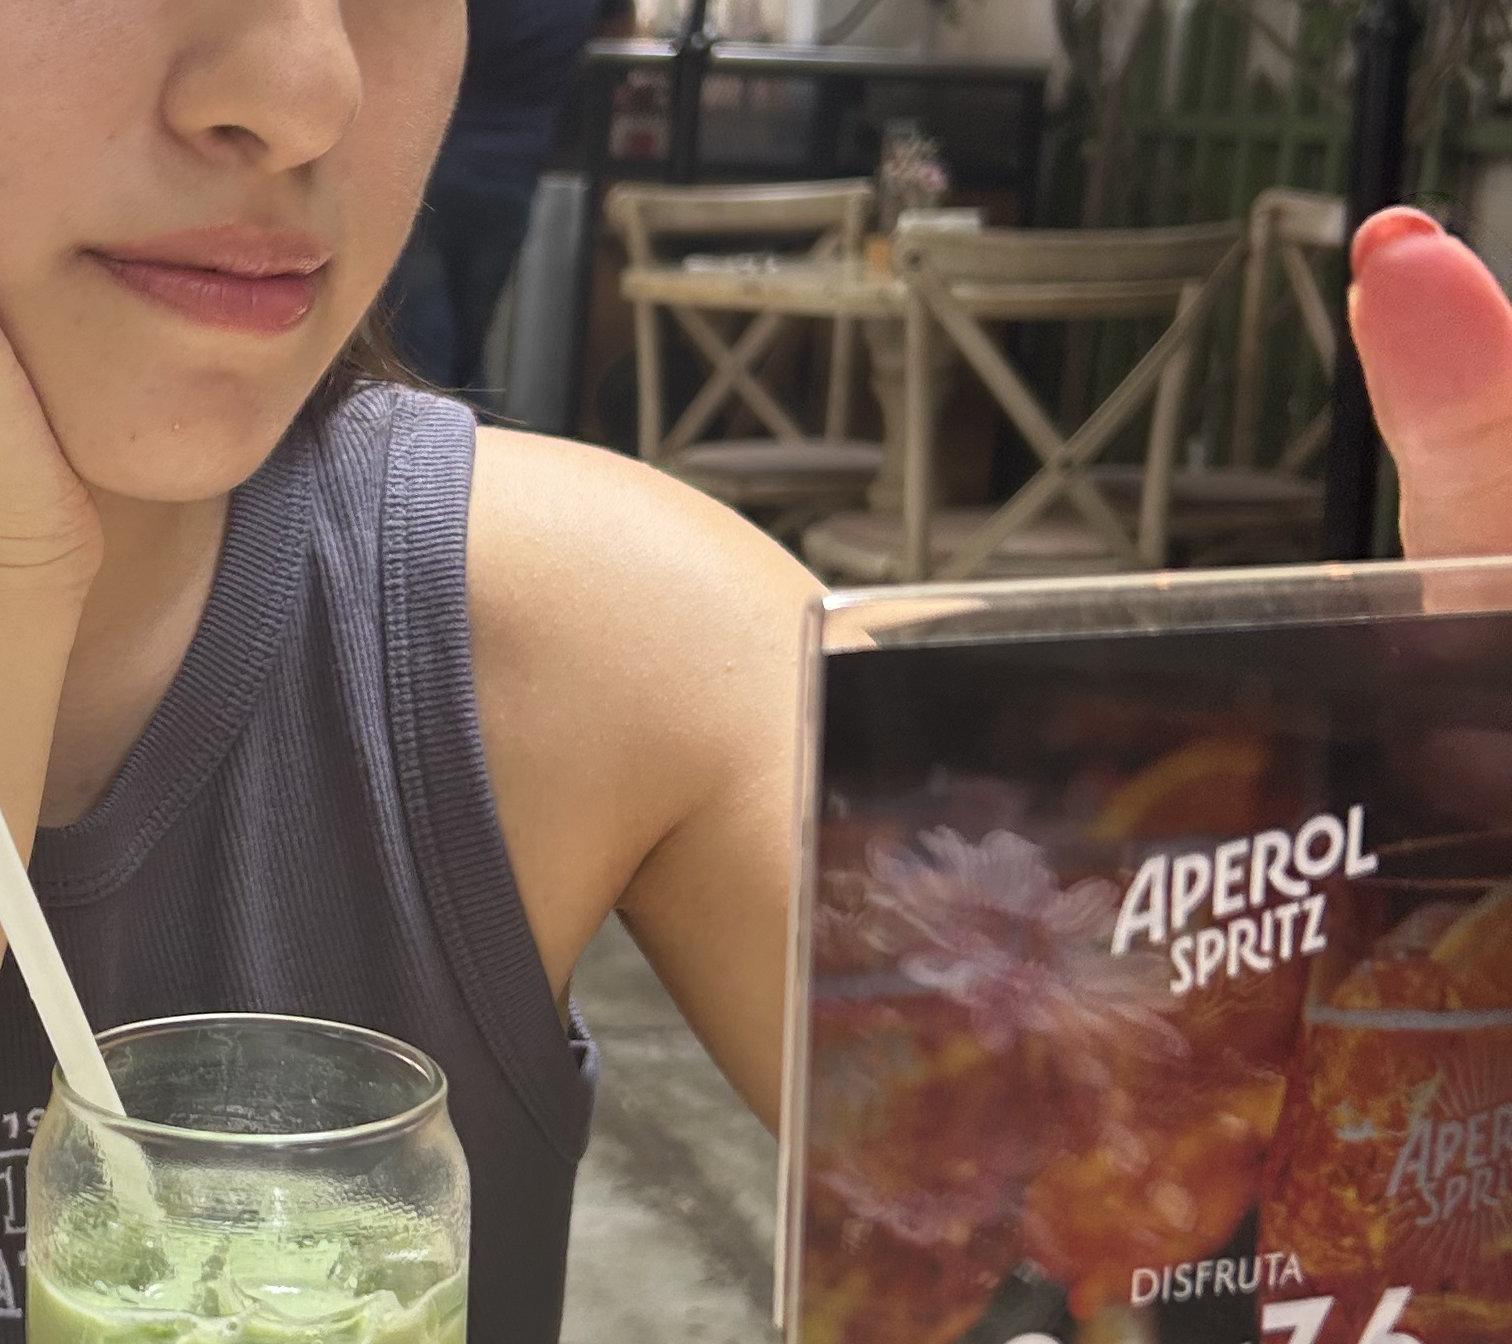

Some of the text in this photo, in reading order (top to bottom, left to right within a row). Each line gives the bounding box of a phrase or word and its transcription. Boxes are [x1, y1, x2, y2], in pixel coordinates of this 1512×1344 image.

[1110, 802, 1380, 958] APEROL
[1169, 893, 1328, 996] SPRITZ
[1130, 1251, 1304, 1307] DISFRUTA
